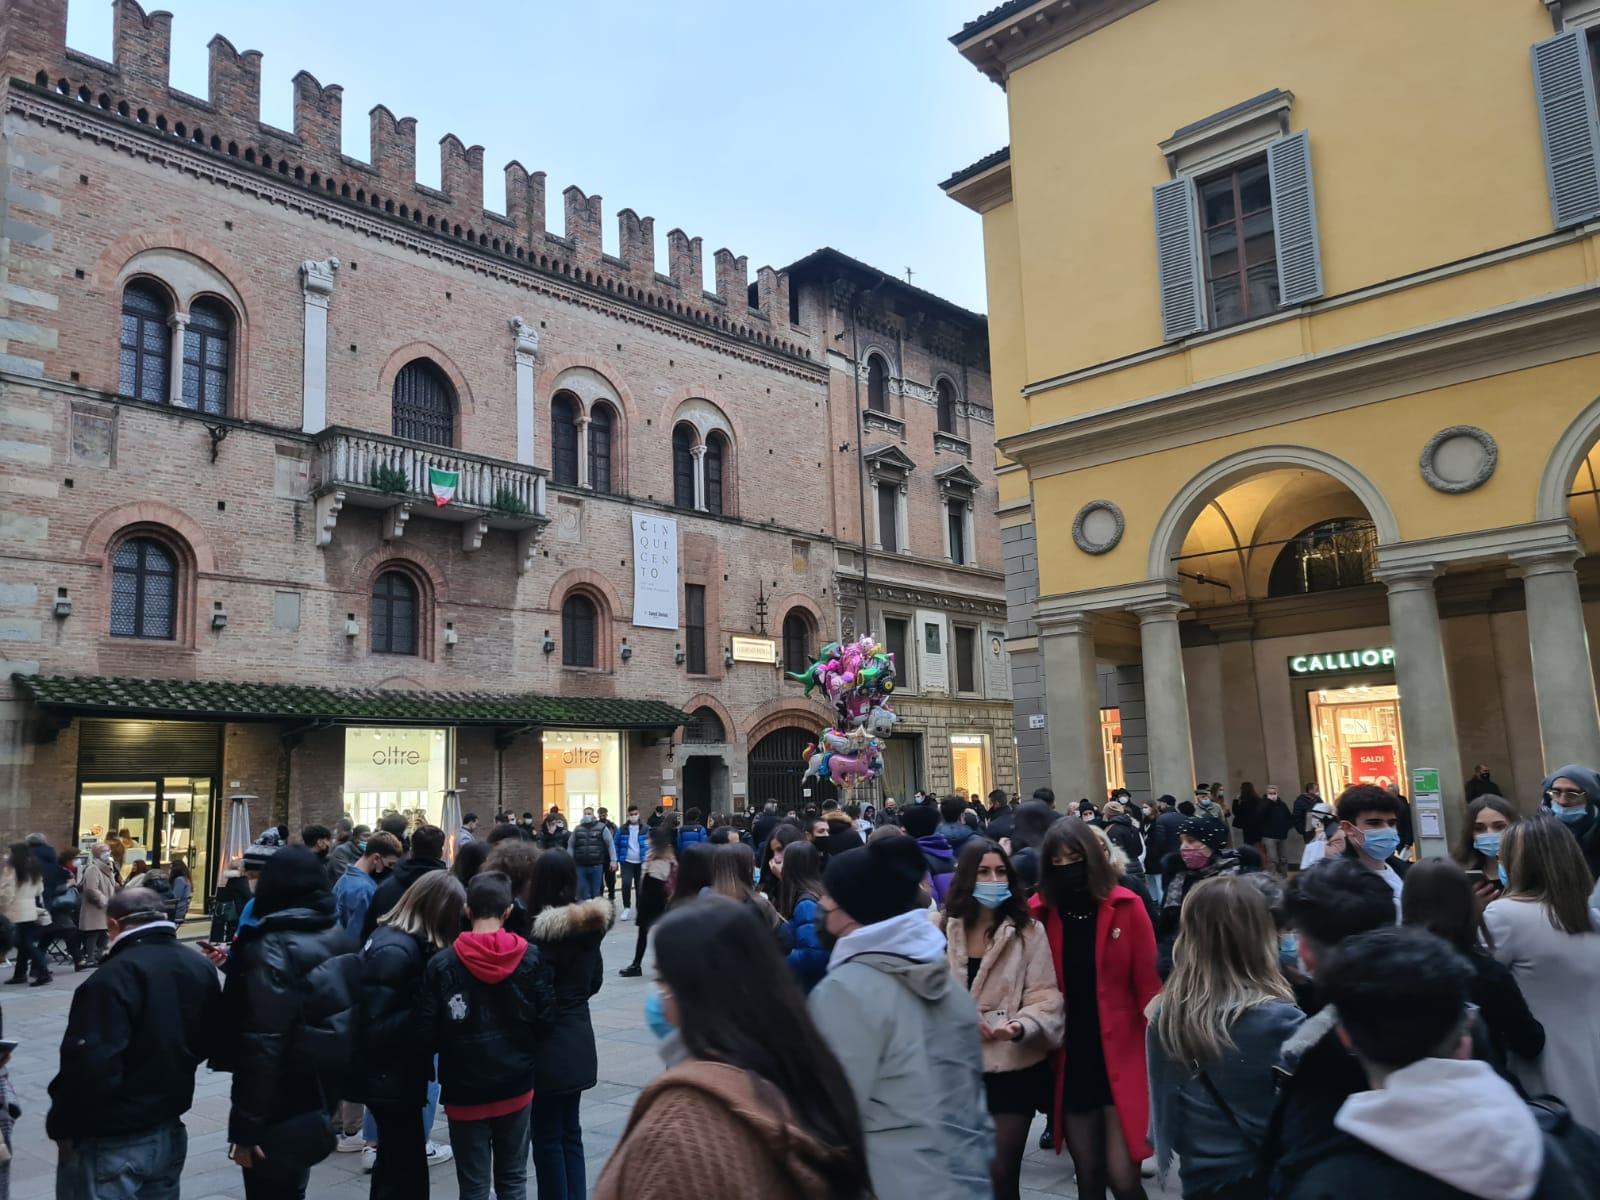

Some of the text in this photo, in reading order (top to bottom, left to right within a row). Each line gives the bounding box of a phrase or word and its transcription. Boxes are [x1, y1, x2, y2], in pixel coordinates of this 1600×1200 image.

[1293, 649, 1395, 672] CALLIOP
[372, 746, 420, 765] oltre
[562, 746, 600, 764] oltre
[1360, 755, 1384, 763] SALDI
